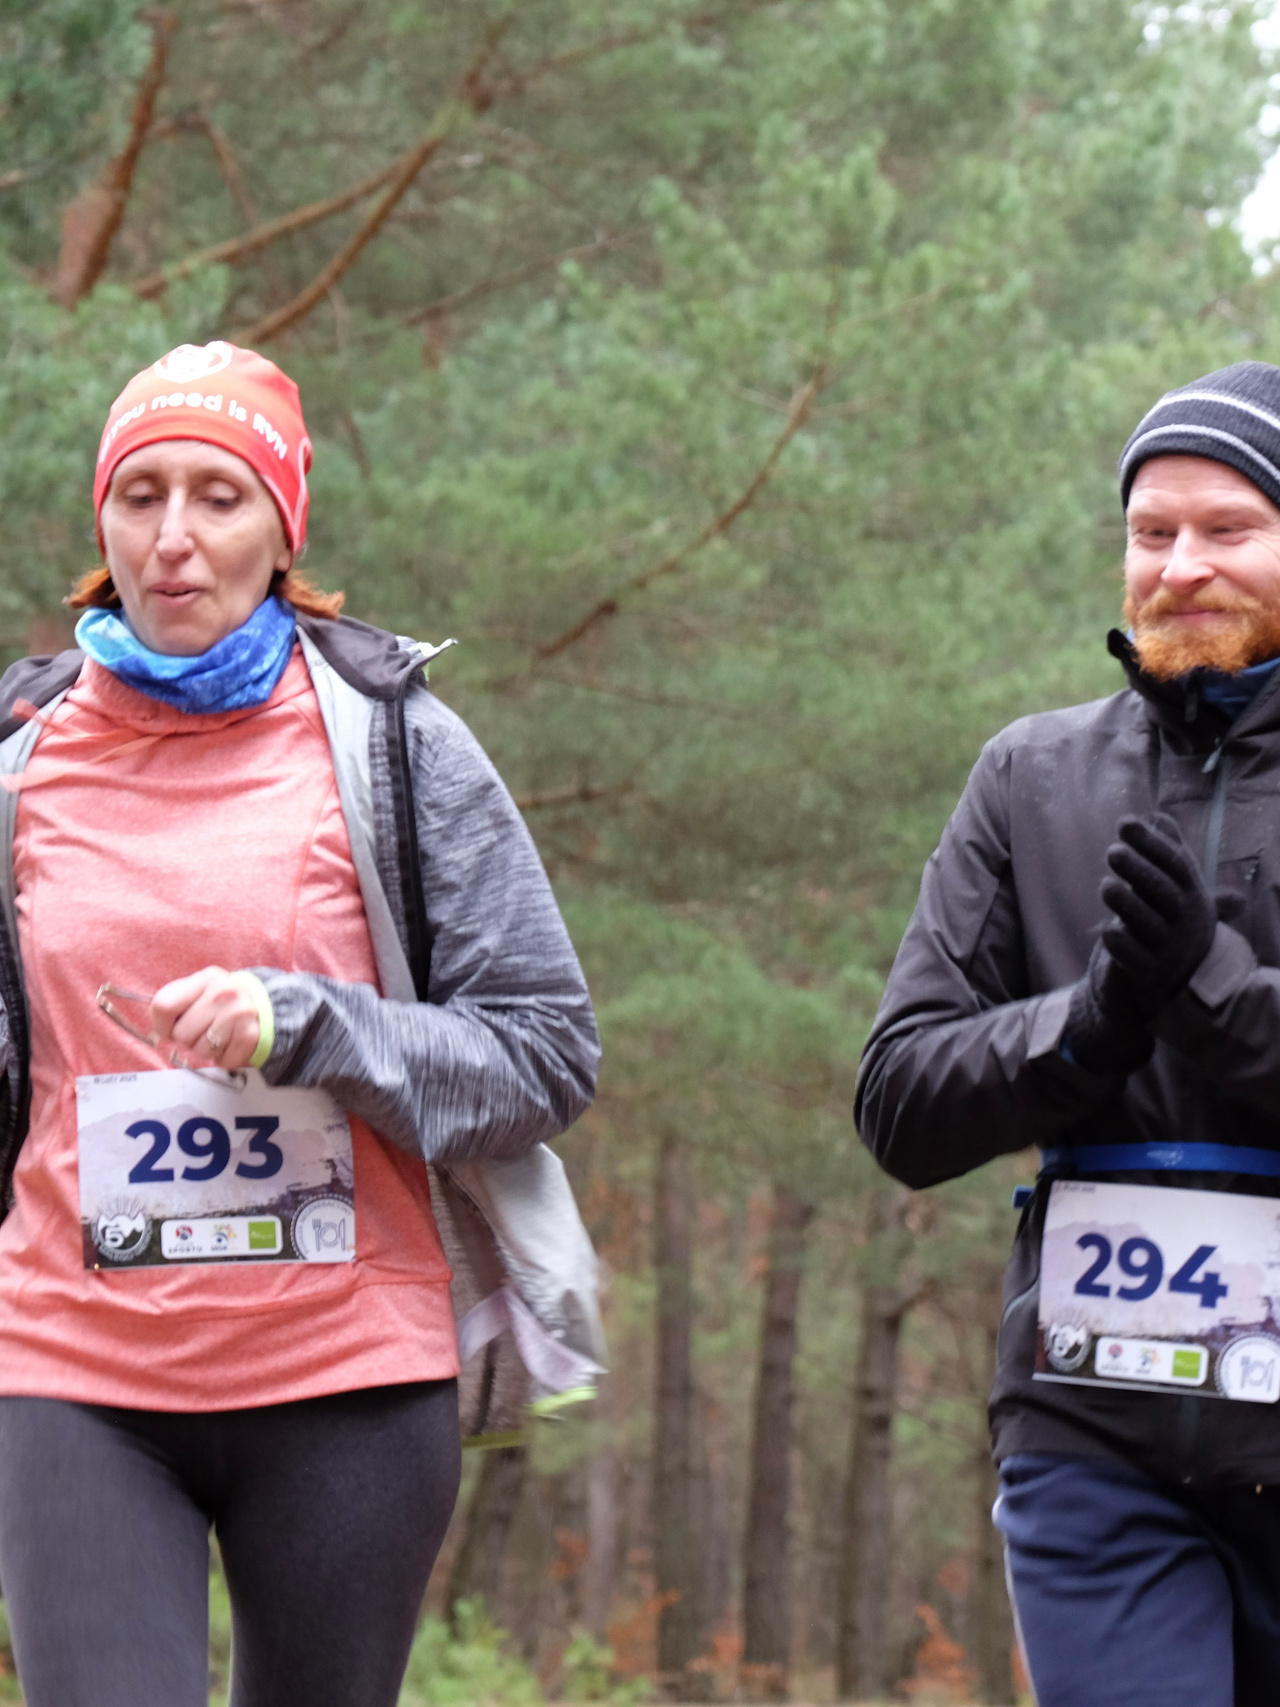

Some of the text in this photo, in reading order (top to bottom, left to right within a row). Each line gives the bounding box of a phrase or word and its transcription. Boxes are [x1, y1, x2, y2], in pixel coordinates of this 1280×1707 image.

[110, 402, 146, 439] you
[151, 392, 223, 412] need
[228, 400, 247, 422] is
[124, 1116, 284, 1184] 293
[1074, 1232, 1228, 1309] 294
